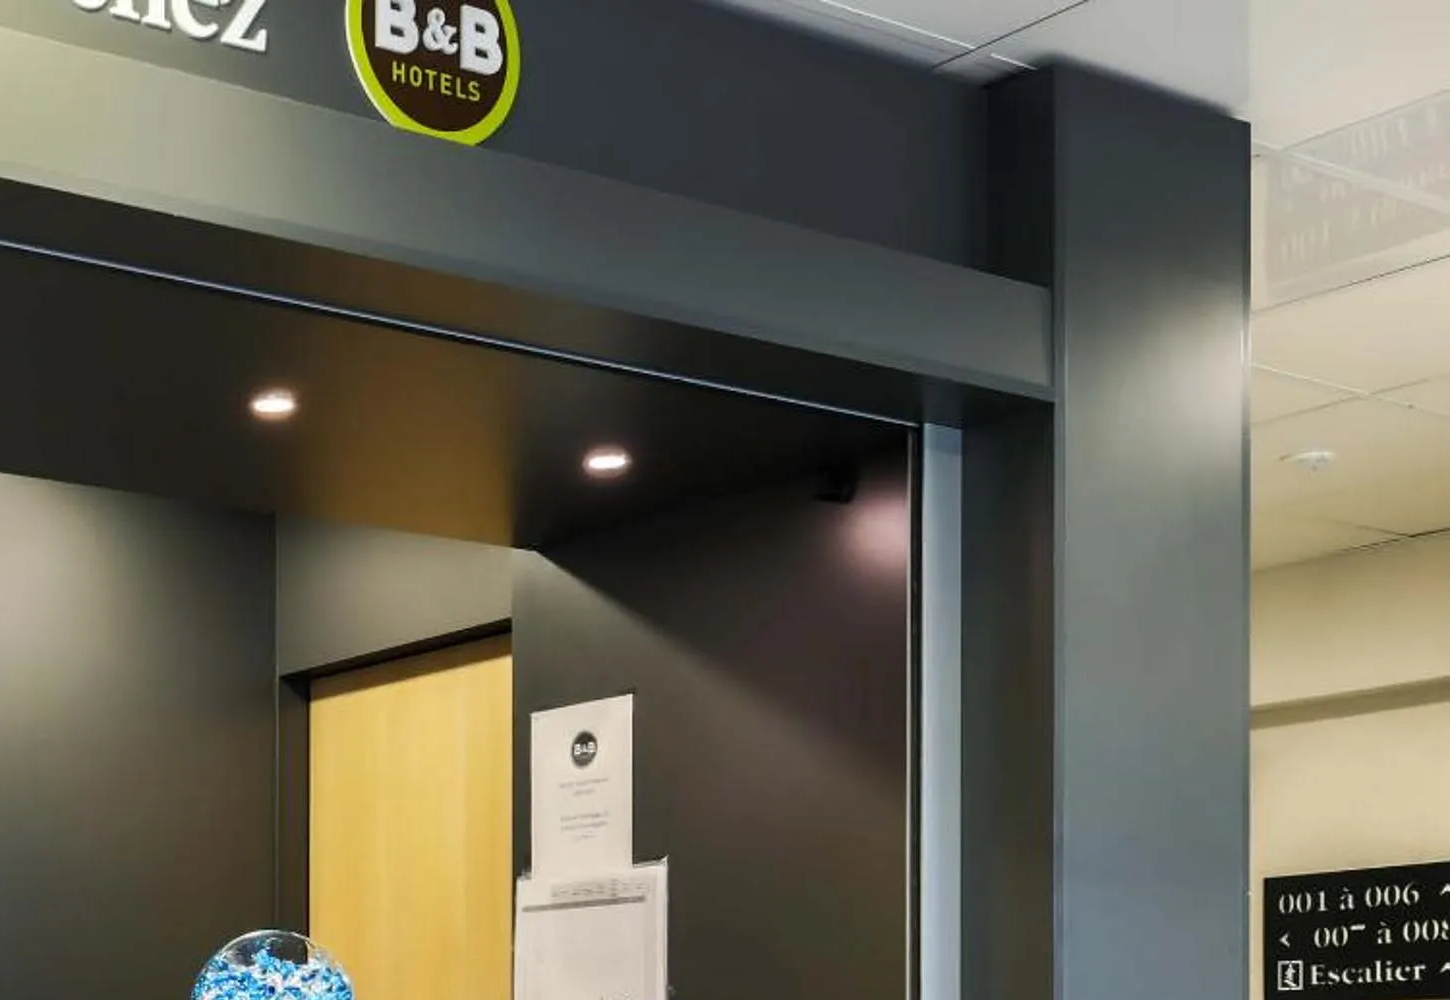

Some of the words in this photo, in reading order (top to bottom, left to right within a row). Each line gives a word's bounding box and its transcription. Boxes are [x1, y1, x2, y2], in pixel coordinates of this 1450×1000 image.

[73, 0, 268, 52] ez
[375, 0, 504, 75] B&B
[393, 60, 482, 101] HOTELS
[1278, 890, 1329, 914] 001
[1339, 887, 1355, 911] à
[1365, 883, 1421, 908] 006
[1377, 921, 1393, 945] à
[1310, 960, 1427, 985] Escalier
